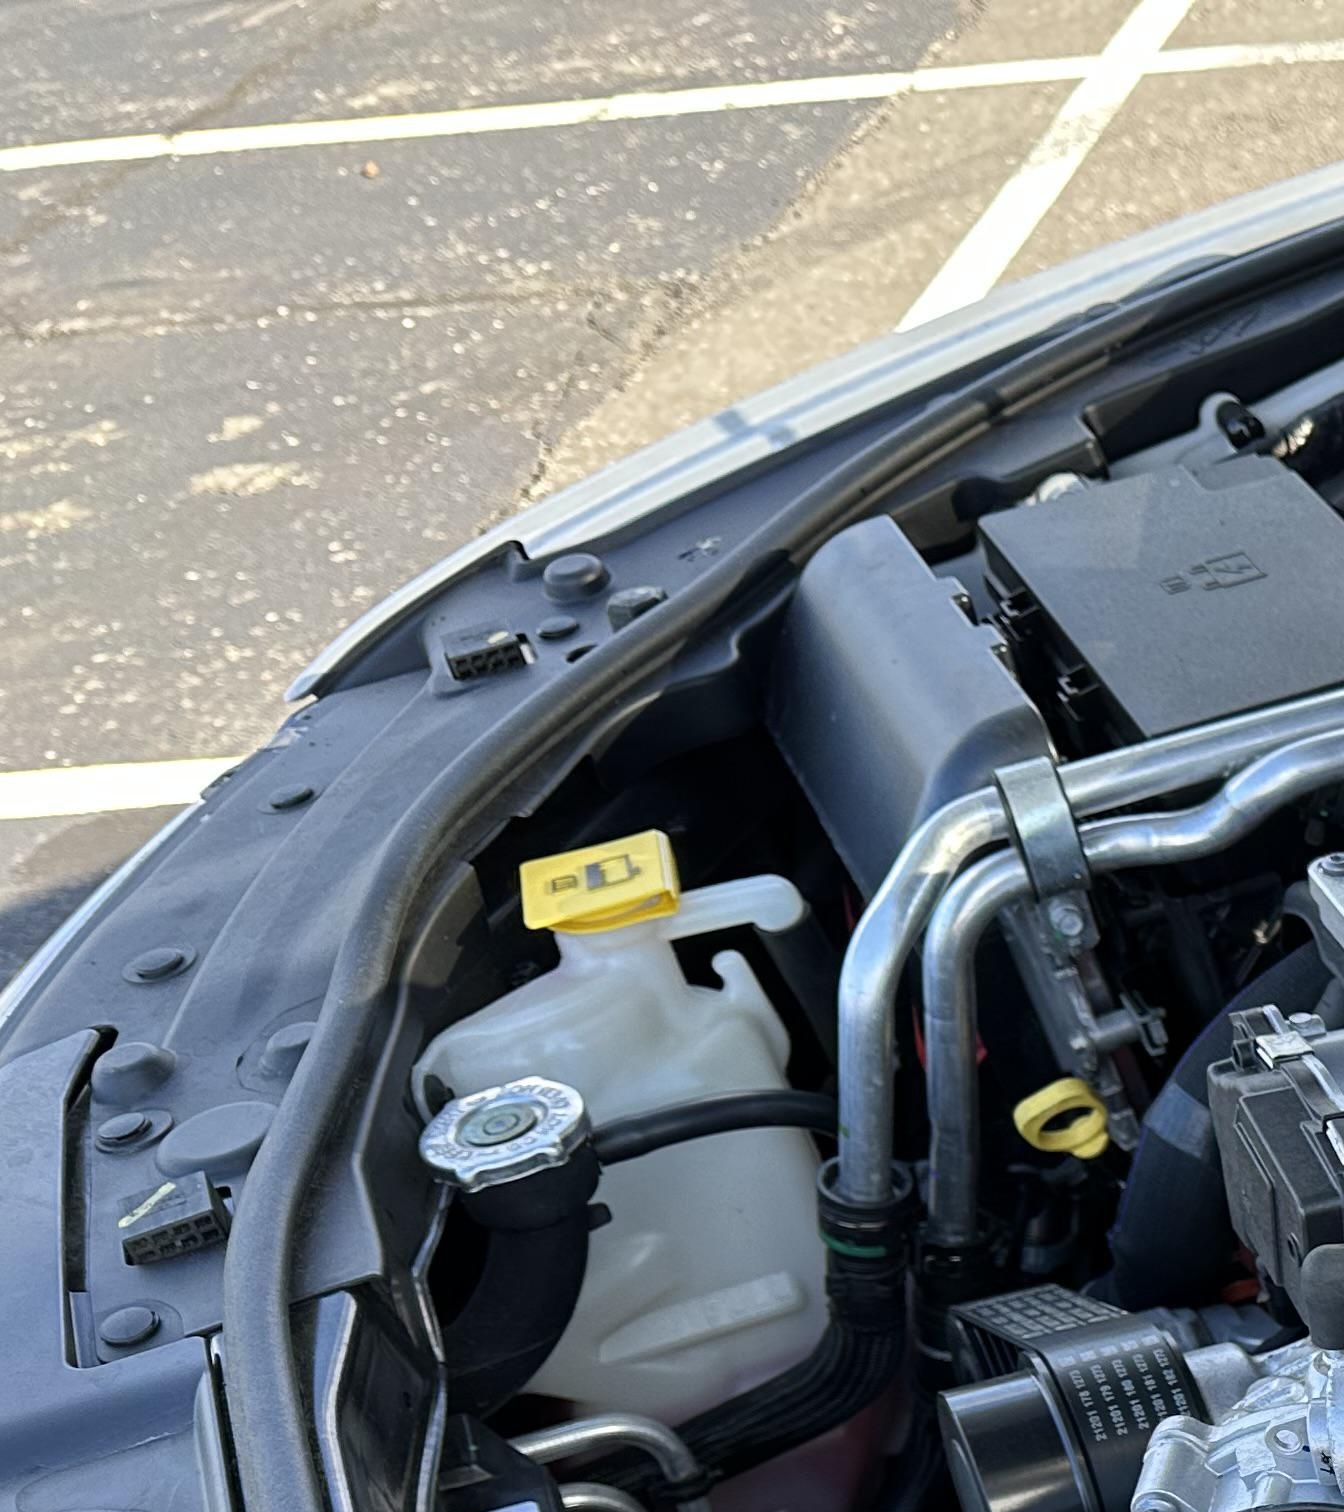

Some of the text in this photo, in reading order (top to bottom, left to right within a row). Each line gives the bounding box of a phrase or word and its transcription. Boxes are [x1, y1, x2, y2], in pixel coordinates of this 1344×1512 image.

[1084, 1411, 1108, 1443] 21201
[1107, 1405, 1130, 1437] 21201
[1129, 1399, 1151, 1431] 21201
